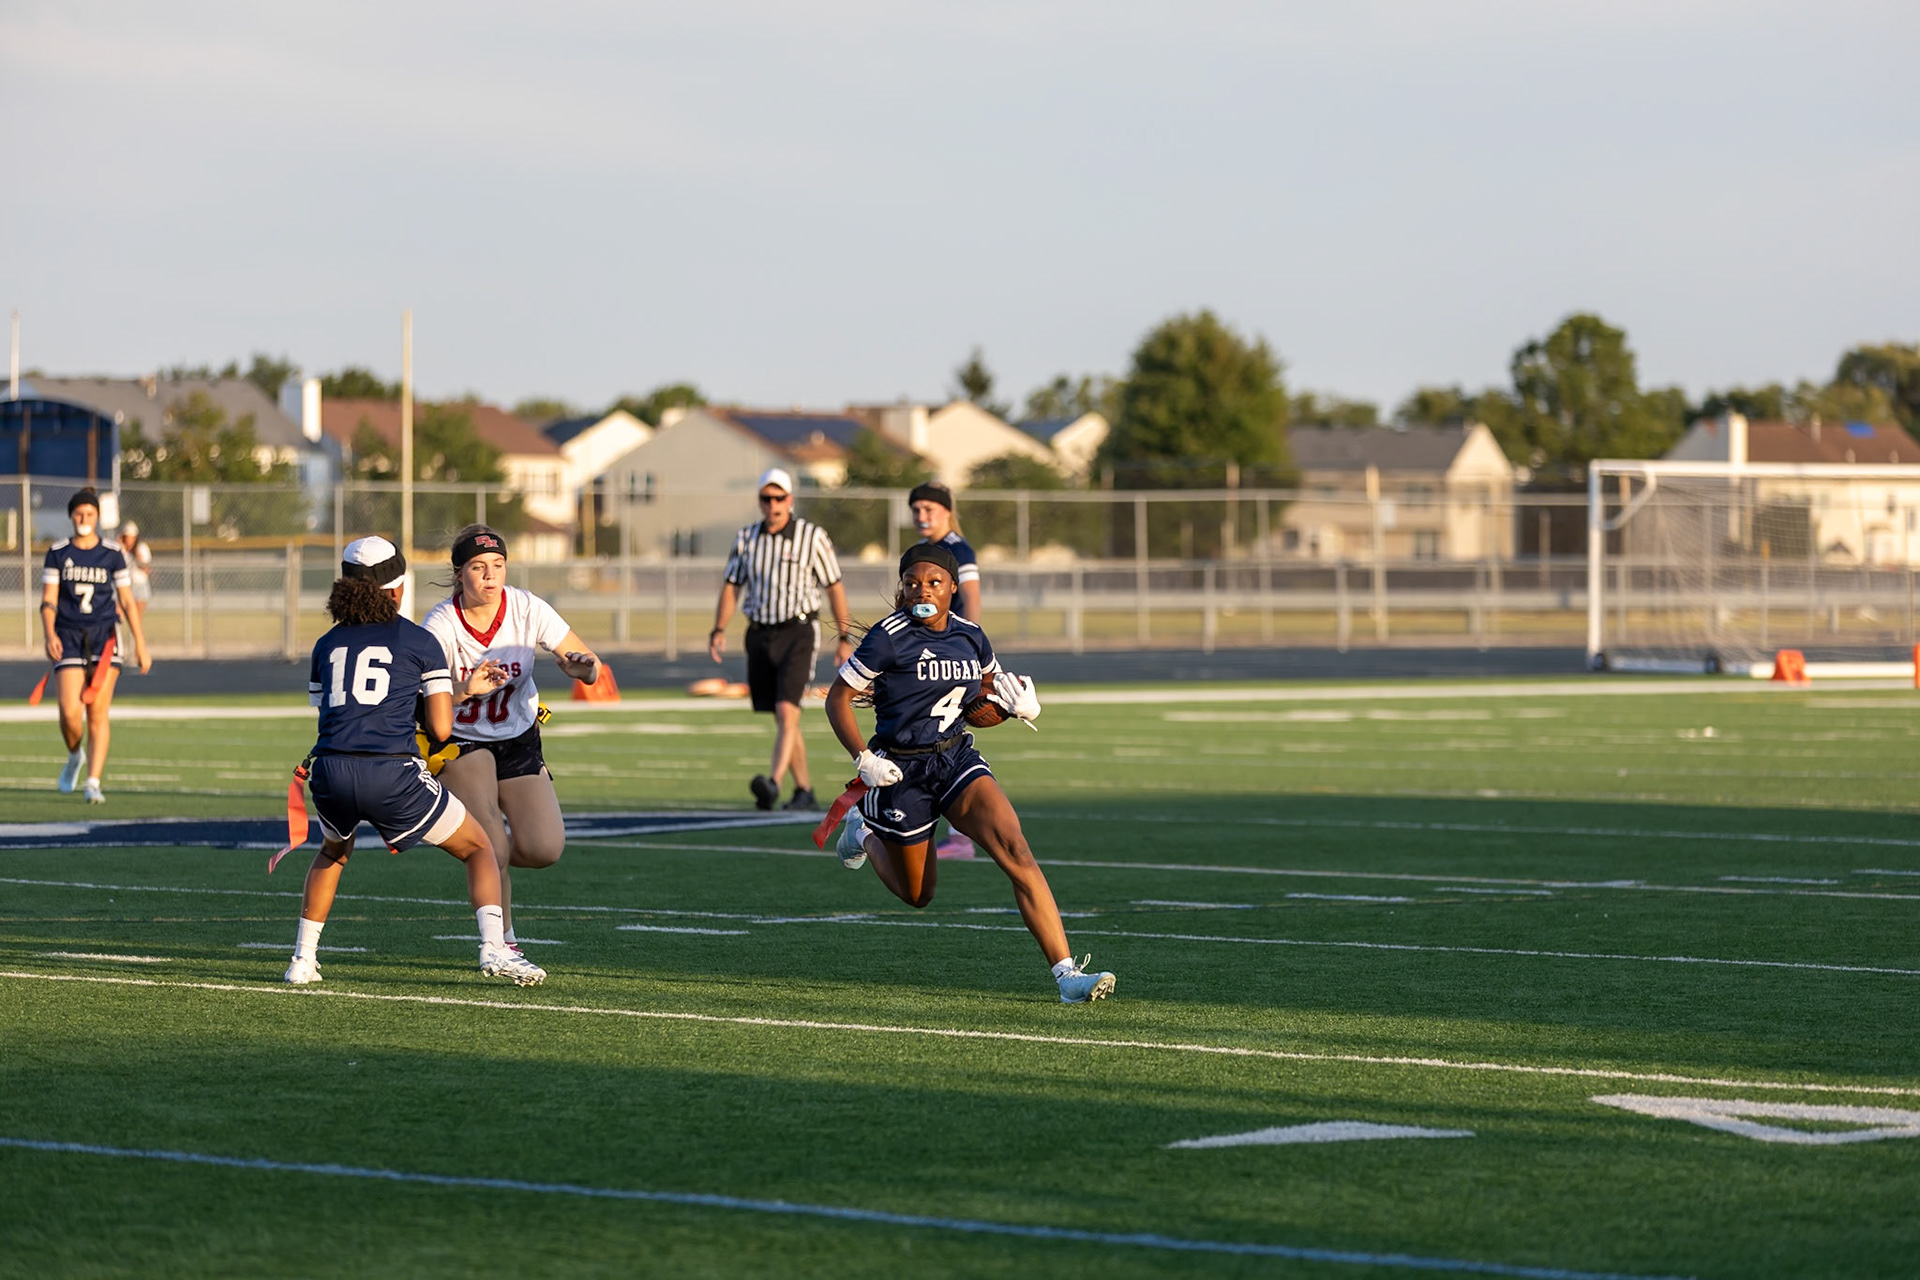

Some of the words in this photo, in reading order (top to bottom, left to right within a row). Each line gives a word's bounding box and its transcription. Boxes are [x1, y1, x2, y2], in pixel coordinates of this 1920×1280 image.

[62, 565, 108, 584] COUGARS
[74, 583, 95, 614] 7
[329, 646, 393, 708] 16
[916, 659, 983, 681] COUGAR
[930, 686, 967, 733] 4
